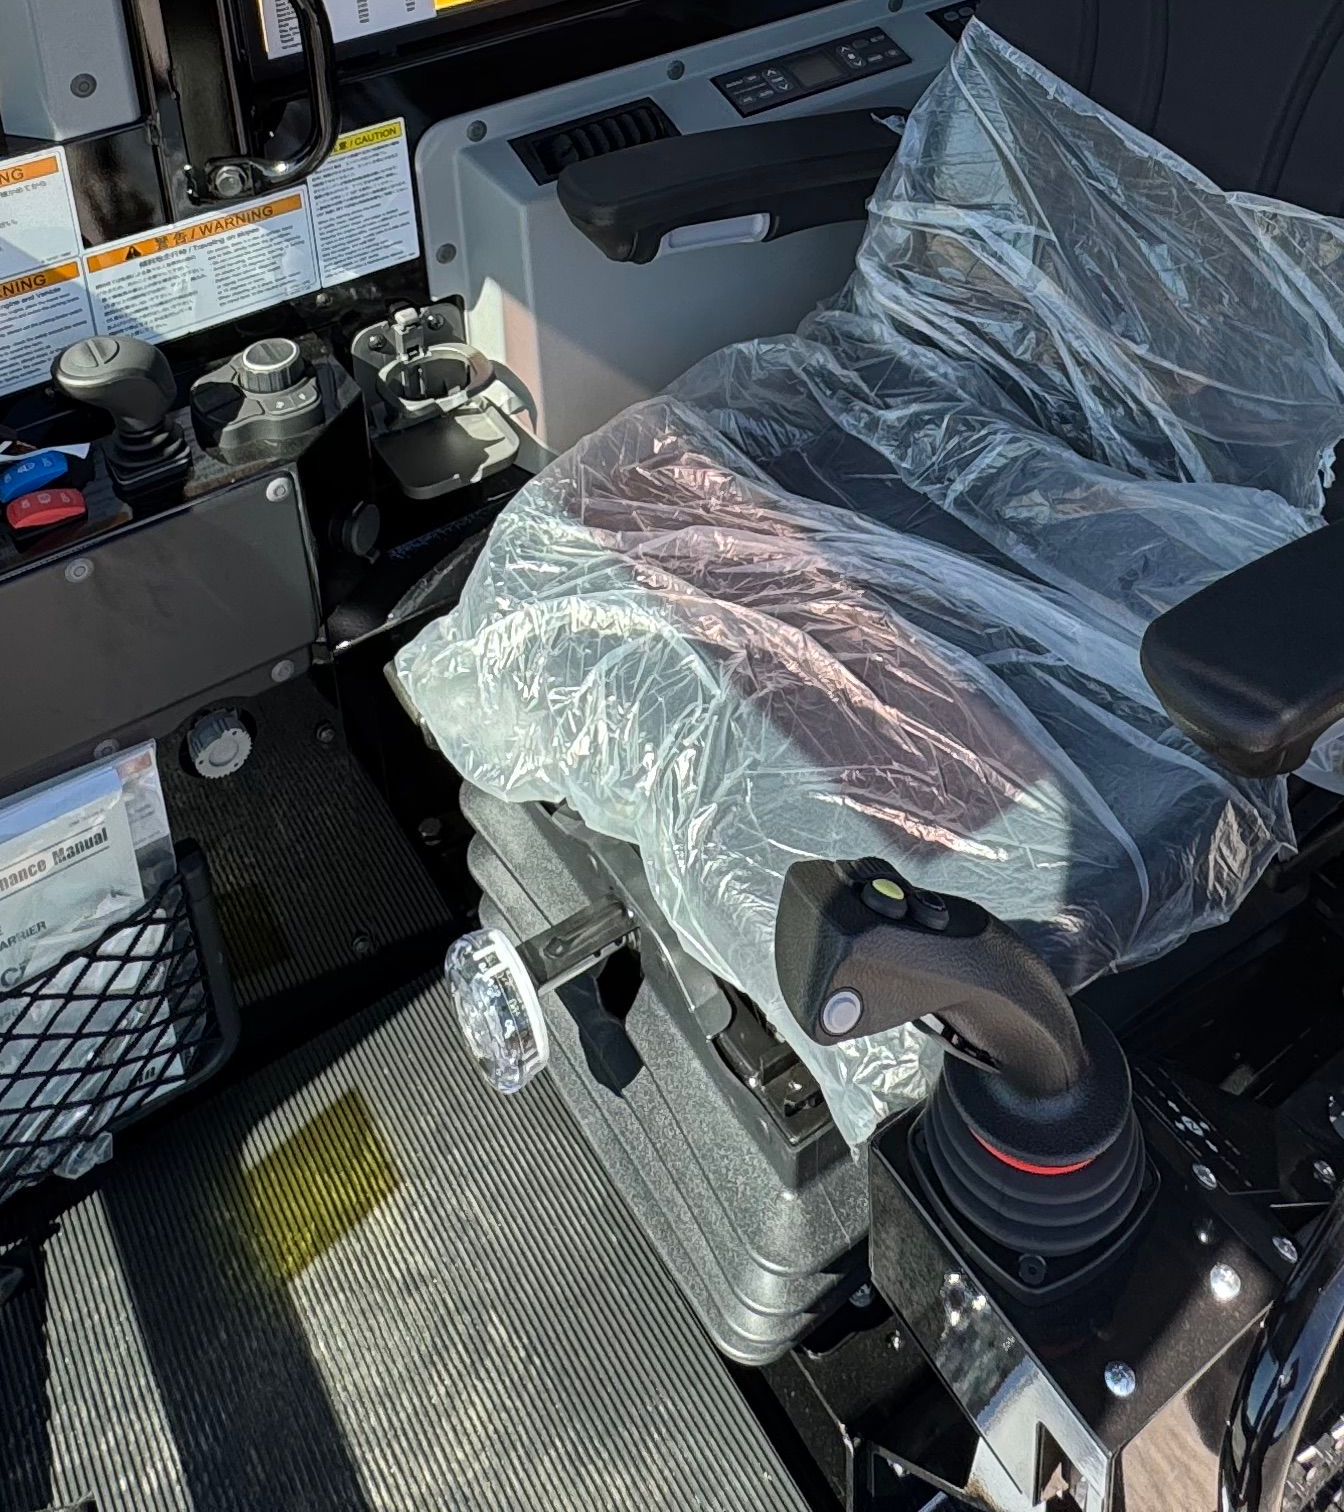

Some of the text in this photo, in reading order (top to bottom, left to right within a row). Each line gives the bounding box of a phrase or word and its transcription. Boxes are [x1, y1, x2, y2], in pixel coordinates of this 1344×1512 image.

[355, 127, 397, 147] CAUTION
[198, 204, 273, 236] WARNING
[21, 294, 34, 303] and
[52, 826, 109, 866] Manual
